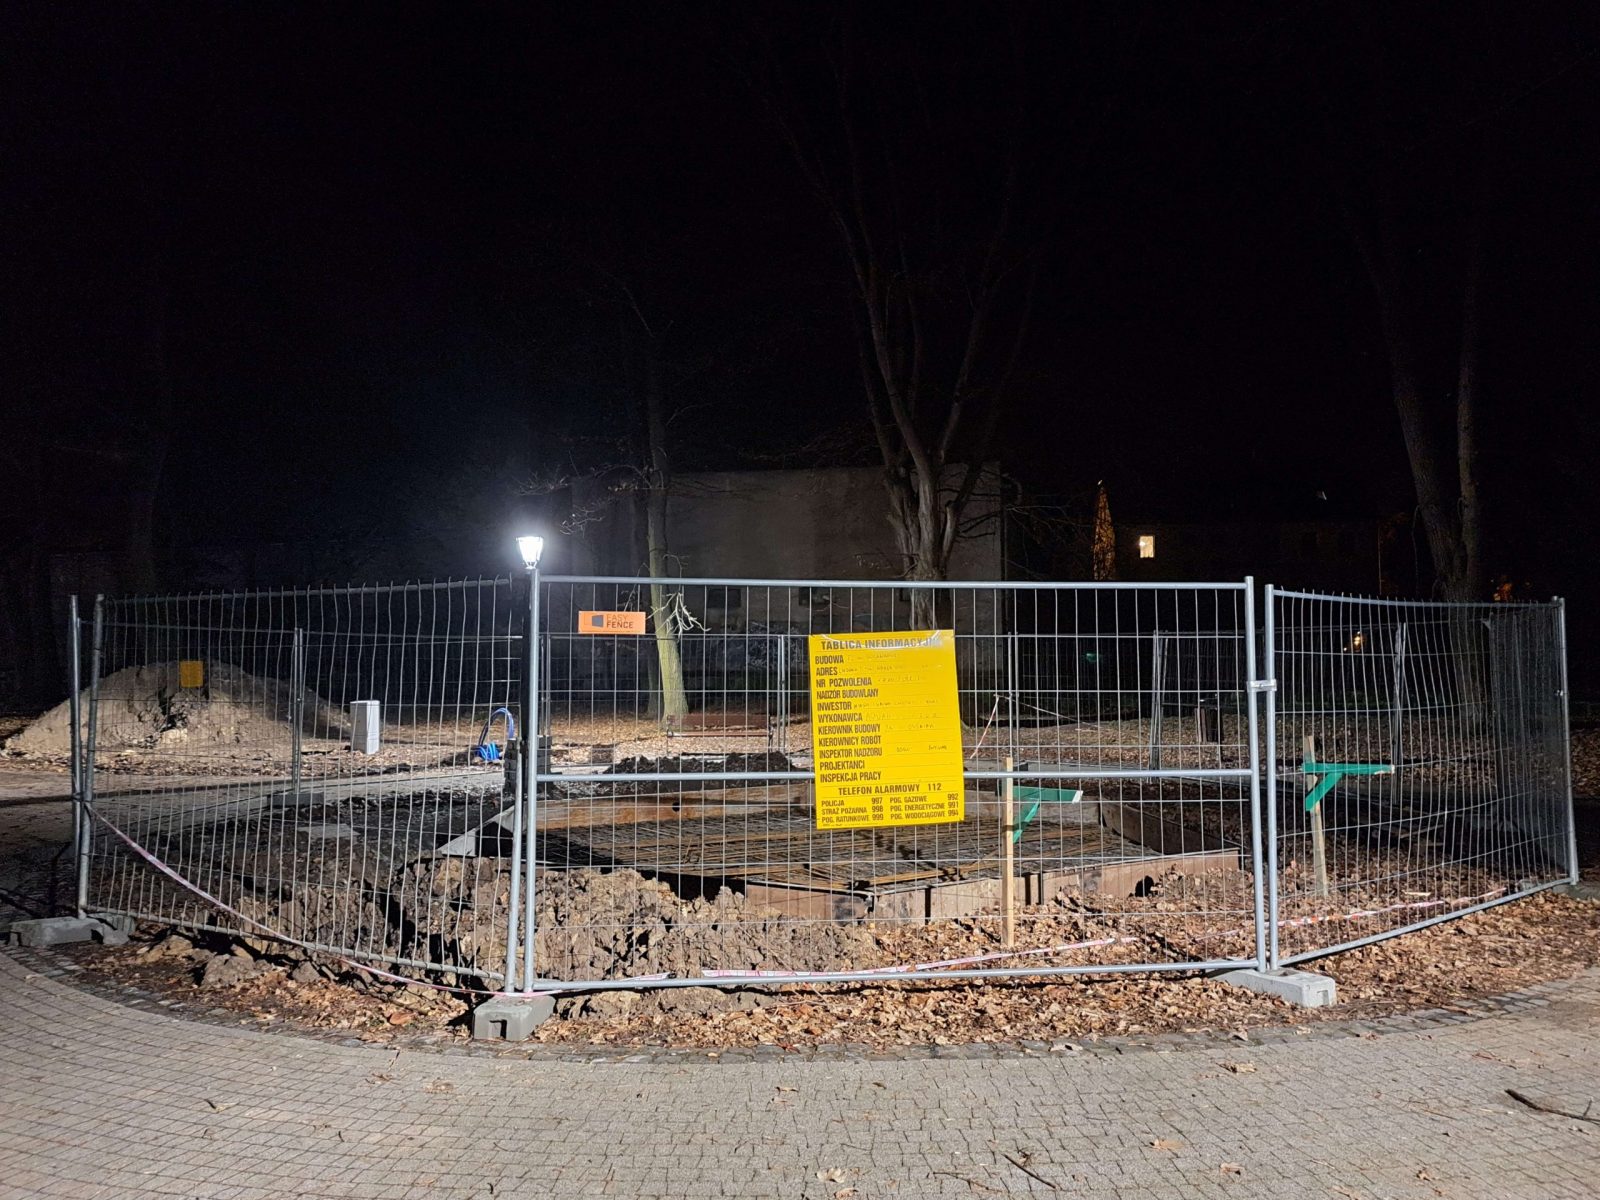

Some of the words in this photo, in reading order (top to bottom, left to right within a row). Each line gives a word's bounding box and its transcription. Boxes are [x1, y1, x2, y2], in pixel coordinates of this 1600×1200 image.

[821, 640, 862, 650] TABLICA
[815, 655, 844, 665] BUDOWA
[816, 667, 838, 676] ADRES
[816, 679, 826, 688] NR
[829, 677, 873, 687] POZWOLENIA
[817, 688, 841, 700] NADZÓR
[842, 688, 879, 698] BUDOWLANY
[817, 702, 852, 712] INWESTOR
[818, 713, 863, 723] WYKONAWCA
[818, 725, 853, 735] KIEROWNIK
[854, 724, 881, 734] BUDOWY
[818, 736, 860, 747] KIEROWNICY
[819, 749, 854, 759] INSPEKTOR
[820, 760, 865, 771] PROJEKTANCI
[820, 772, 858, 783] INSPEKCJA
[860, 772, 882, 782] PRACY
[838, 786, 872, 796] TELEFON
[874, 784, 920, 794] ALARMOWY
[928, 783, 942, 791] 112
[948, 793, 958, 801] 992
[905, 803, 945, 811] ENERGETYCZNE
[836, 814, 870, 823] RATUNKOWE
